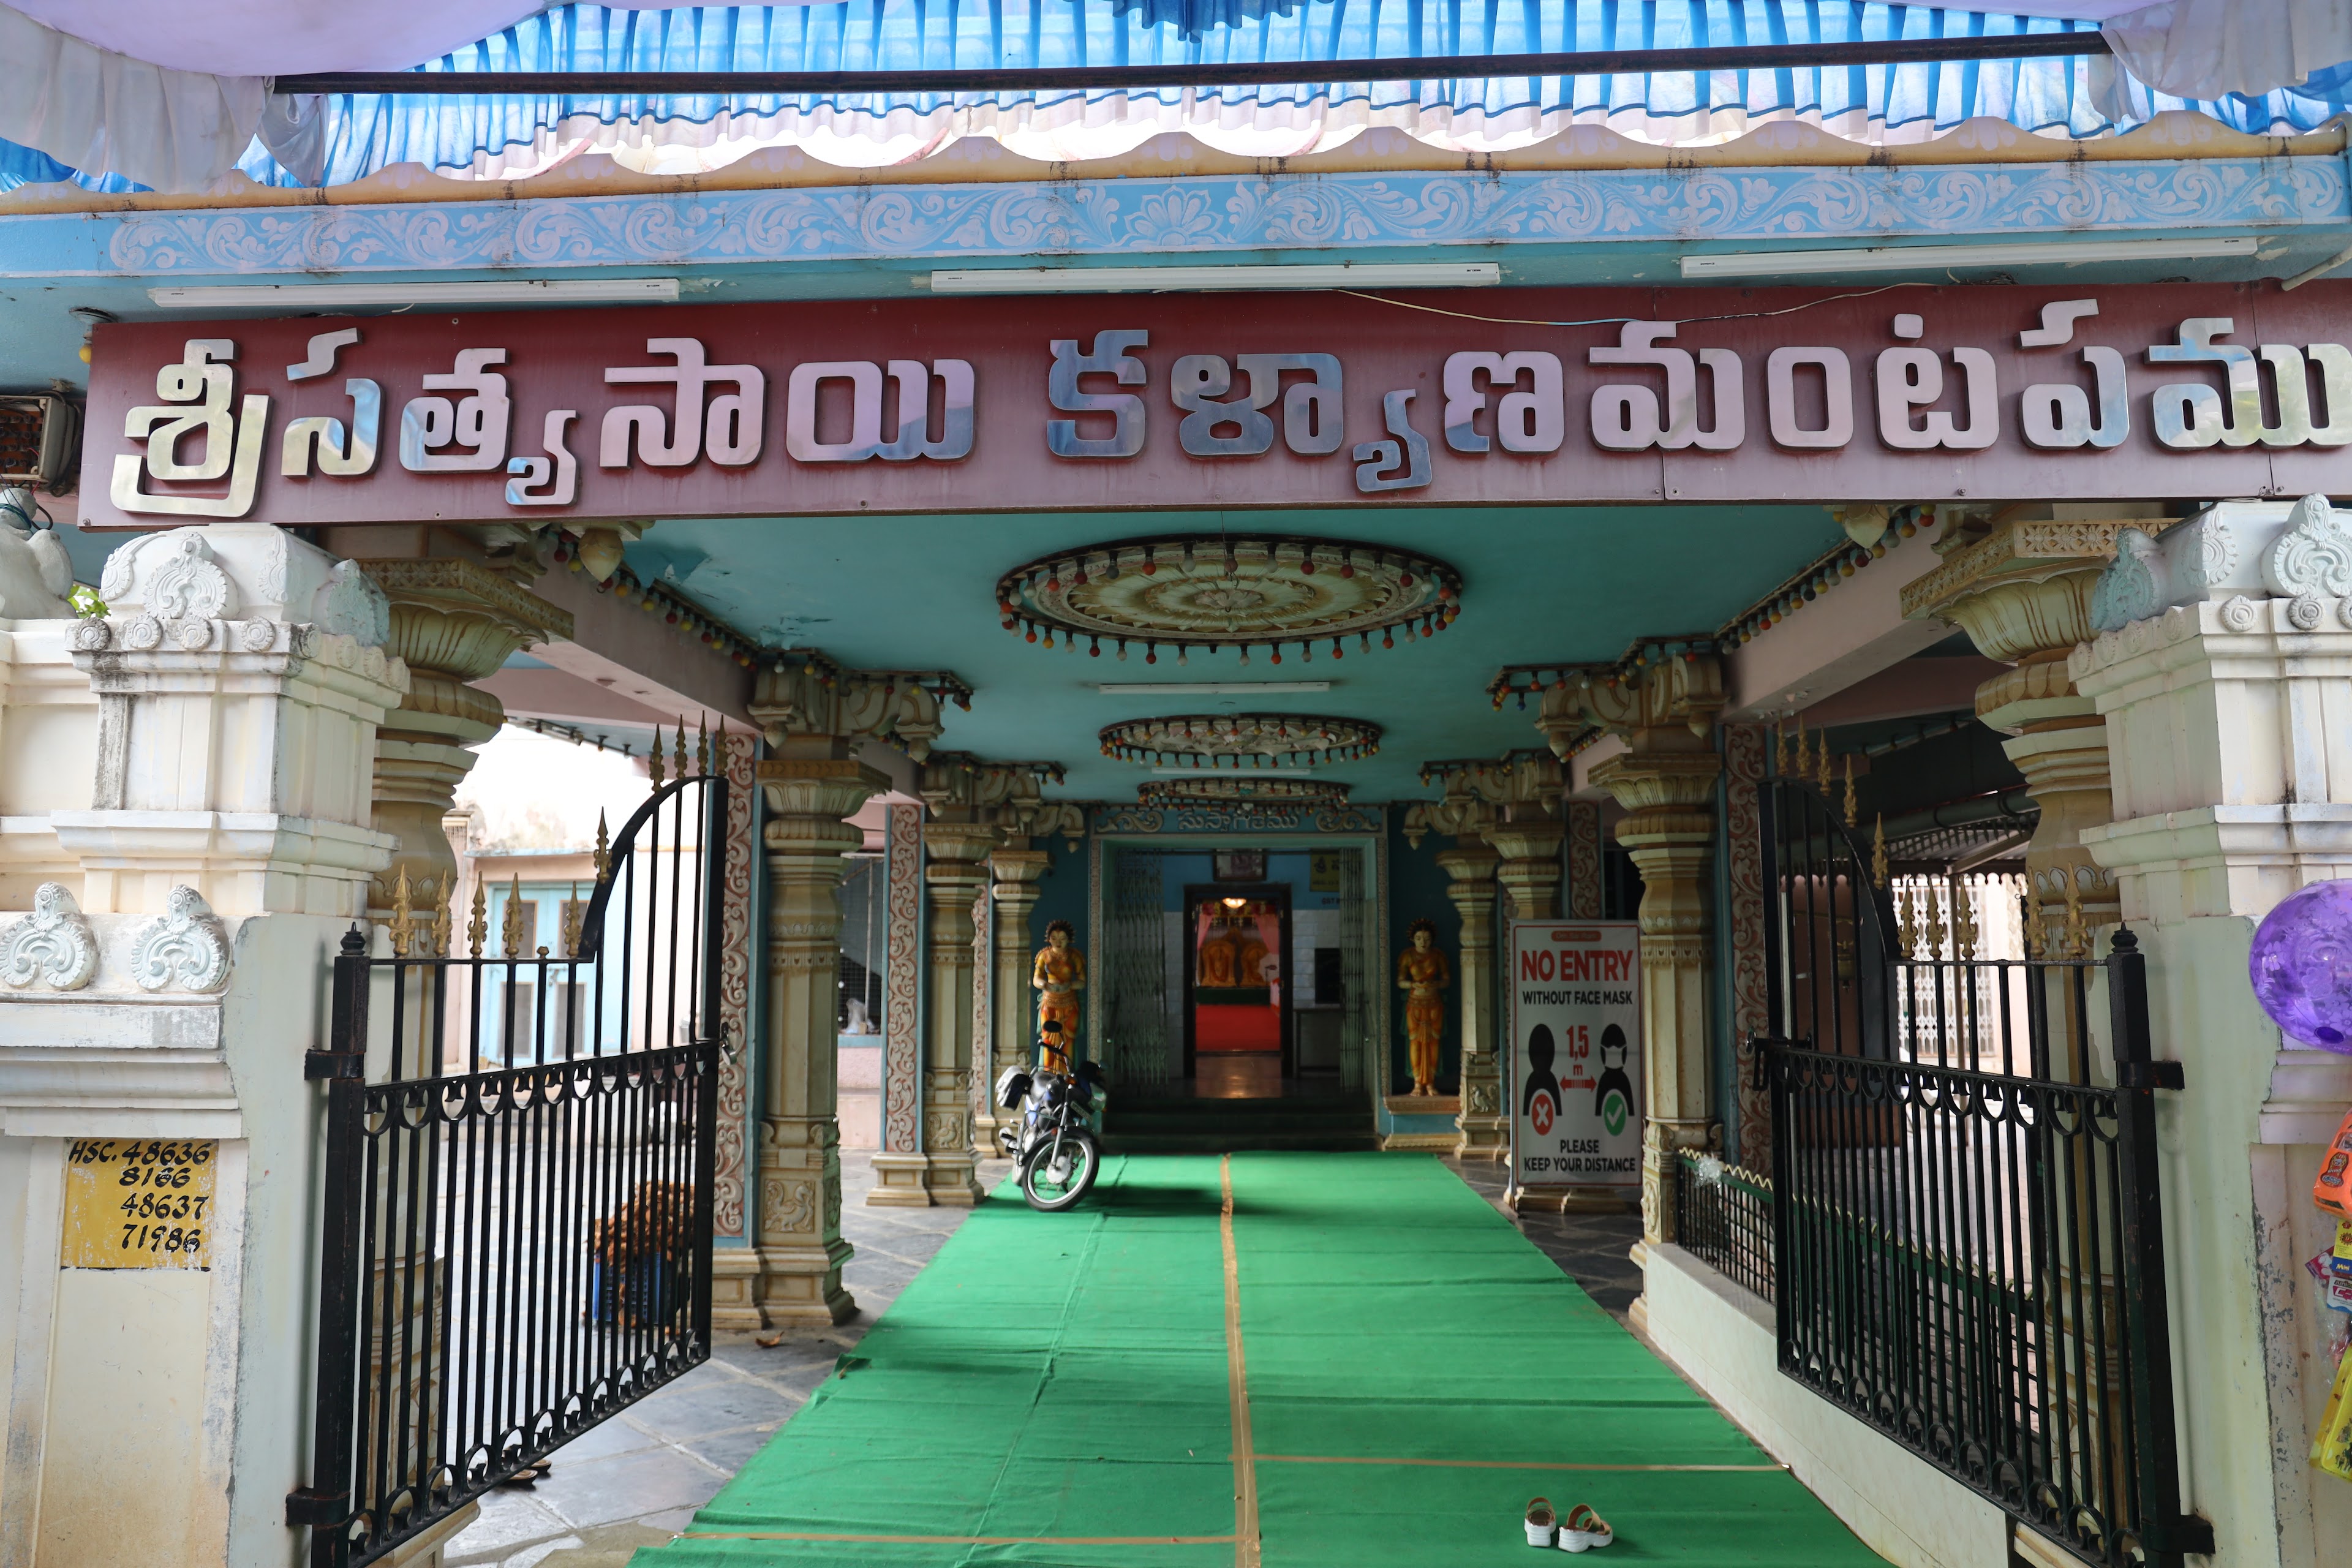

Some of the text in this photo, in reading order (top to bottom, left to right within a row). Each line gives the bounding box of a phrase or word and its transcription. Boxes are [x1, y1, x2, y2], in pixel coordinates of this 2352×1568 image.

[1521, 950, 1634, 982] NO ENTRY
[1523, 991, 1633, 1005] WITHOUT FACE MASK
[1566, 1025, 1589, 1061] 1,5
[1573, 1065, 1583, 1076] m
[69, 1141, 212, 1166] HSC. 48636
[1560, 1139, 1600, 1154] PLEASE
[1524, 1157, 1636, 1172] KEEP YOUR DISTANCE
[119, 1166, 191, 1189] 8166
[120, 1193, 209, 1219] 48637
[122, 1223, 202, 1254] 71986
